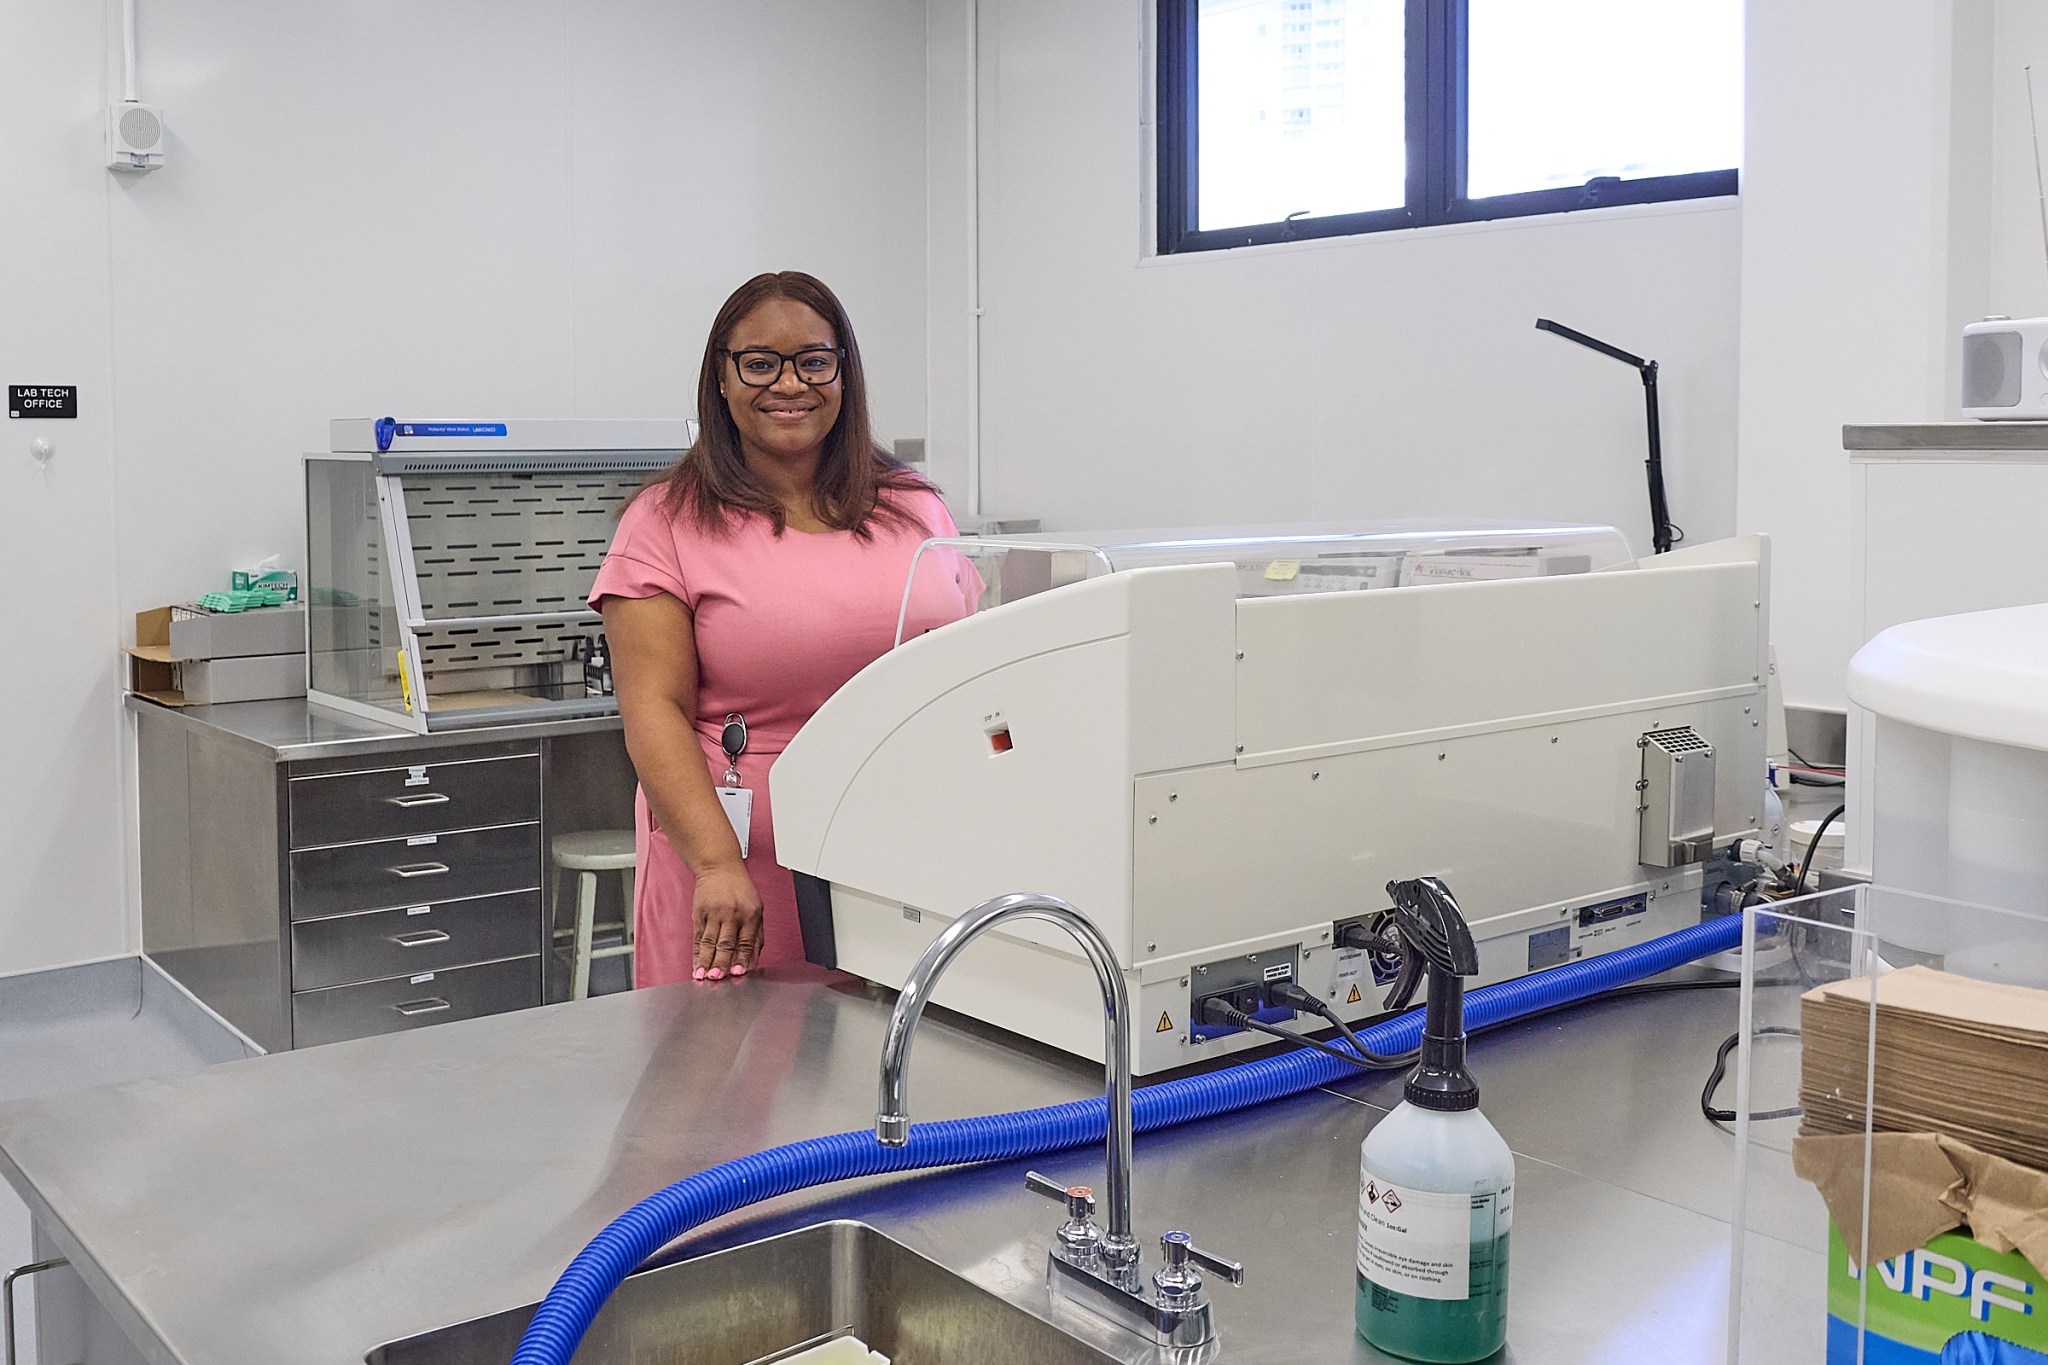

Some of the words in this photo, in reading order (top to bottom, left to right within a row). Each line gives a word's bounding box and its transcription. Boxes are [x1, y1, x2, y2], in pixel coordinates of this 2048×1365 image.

[17, 388, 38, 398] LAB
[40, 388, 69, 398] TECH
[23, 399, 63, 409] OFFICE
[1408, 1258, 1430, 1267] damage
[1401, 1264, 1425, 1273] absorbed
[1426, 1269, 1449, 1277] through
